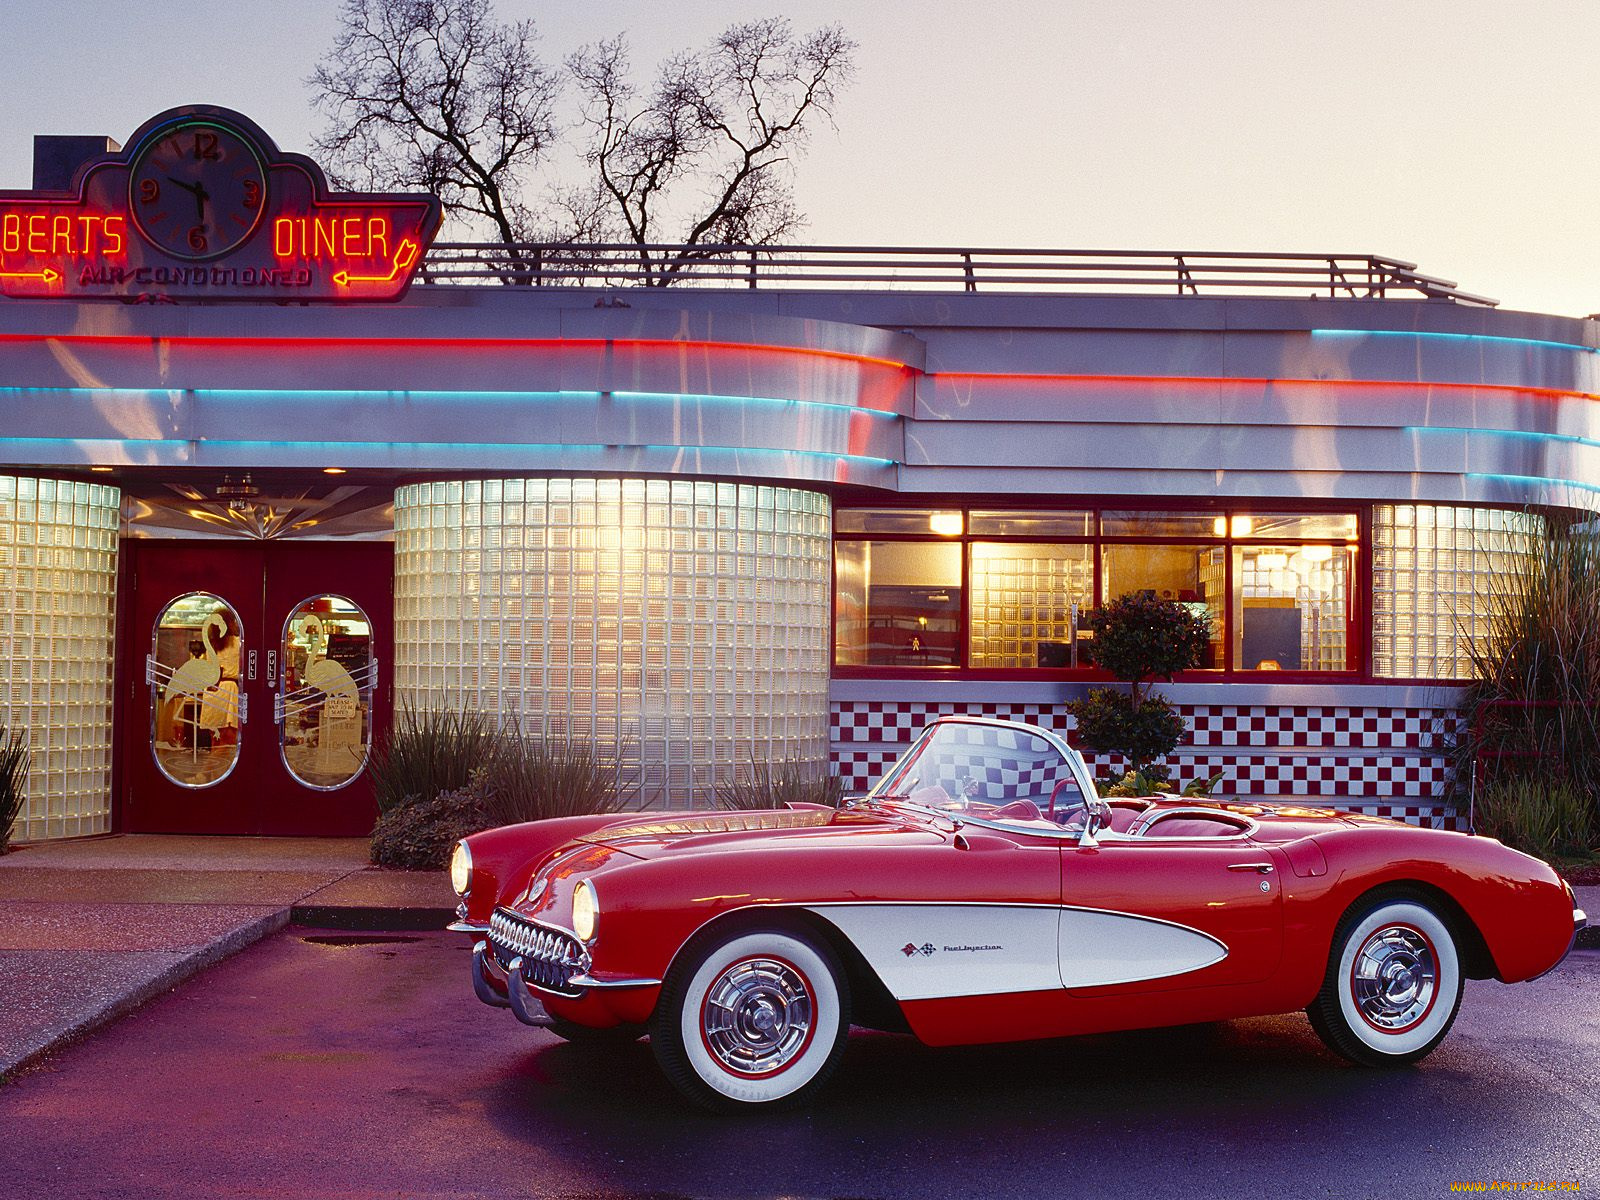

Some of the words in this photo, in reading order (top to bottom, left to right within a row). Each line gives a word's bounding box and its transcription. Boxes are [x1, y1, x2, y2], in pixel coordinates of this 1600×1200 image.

[194, 133, 218, 160] 12
[140, 179, 160, 204] 9
[242, 180, 259, 208] 3
[3, 214, 123, 254] BERTS
[275, 217, 387, 257] DINER
[187, 225, 207, 251] 6
[79, 264, 126, 286] AIR
[135, 266, 312, 287] CONDITIONED
